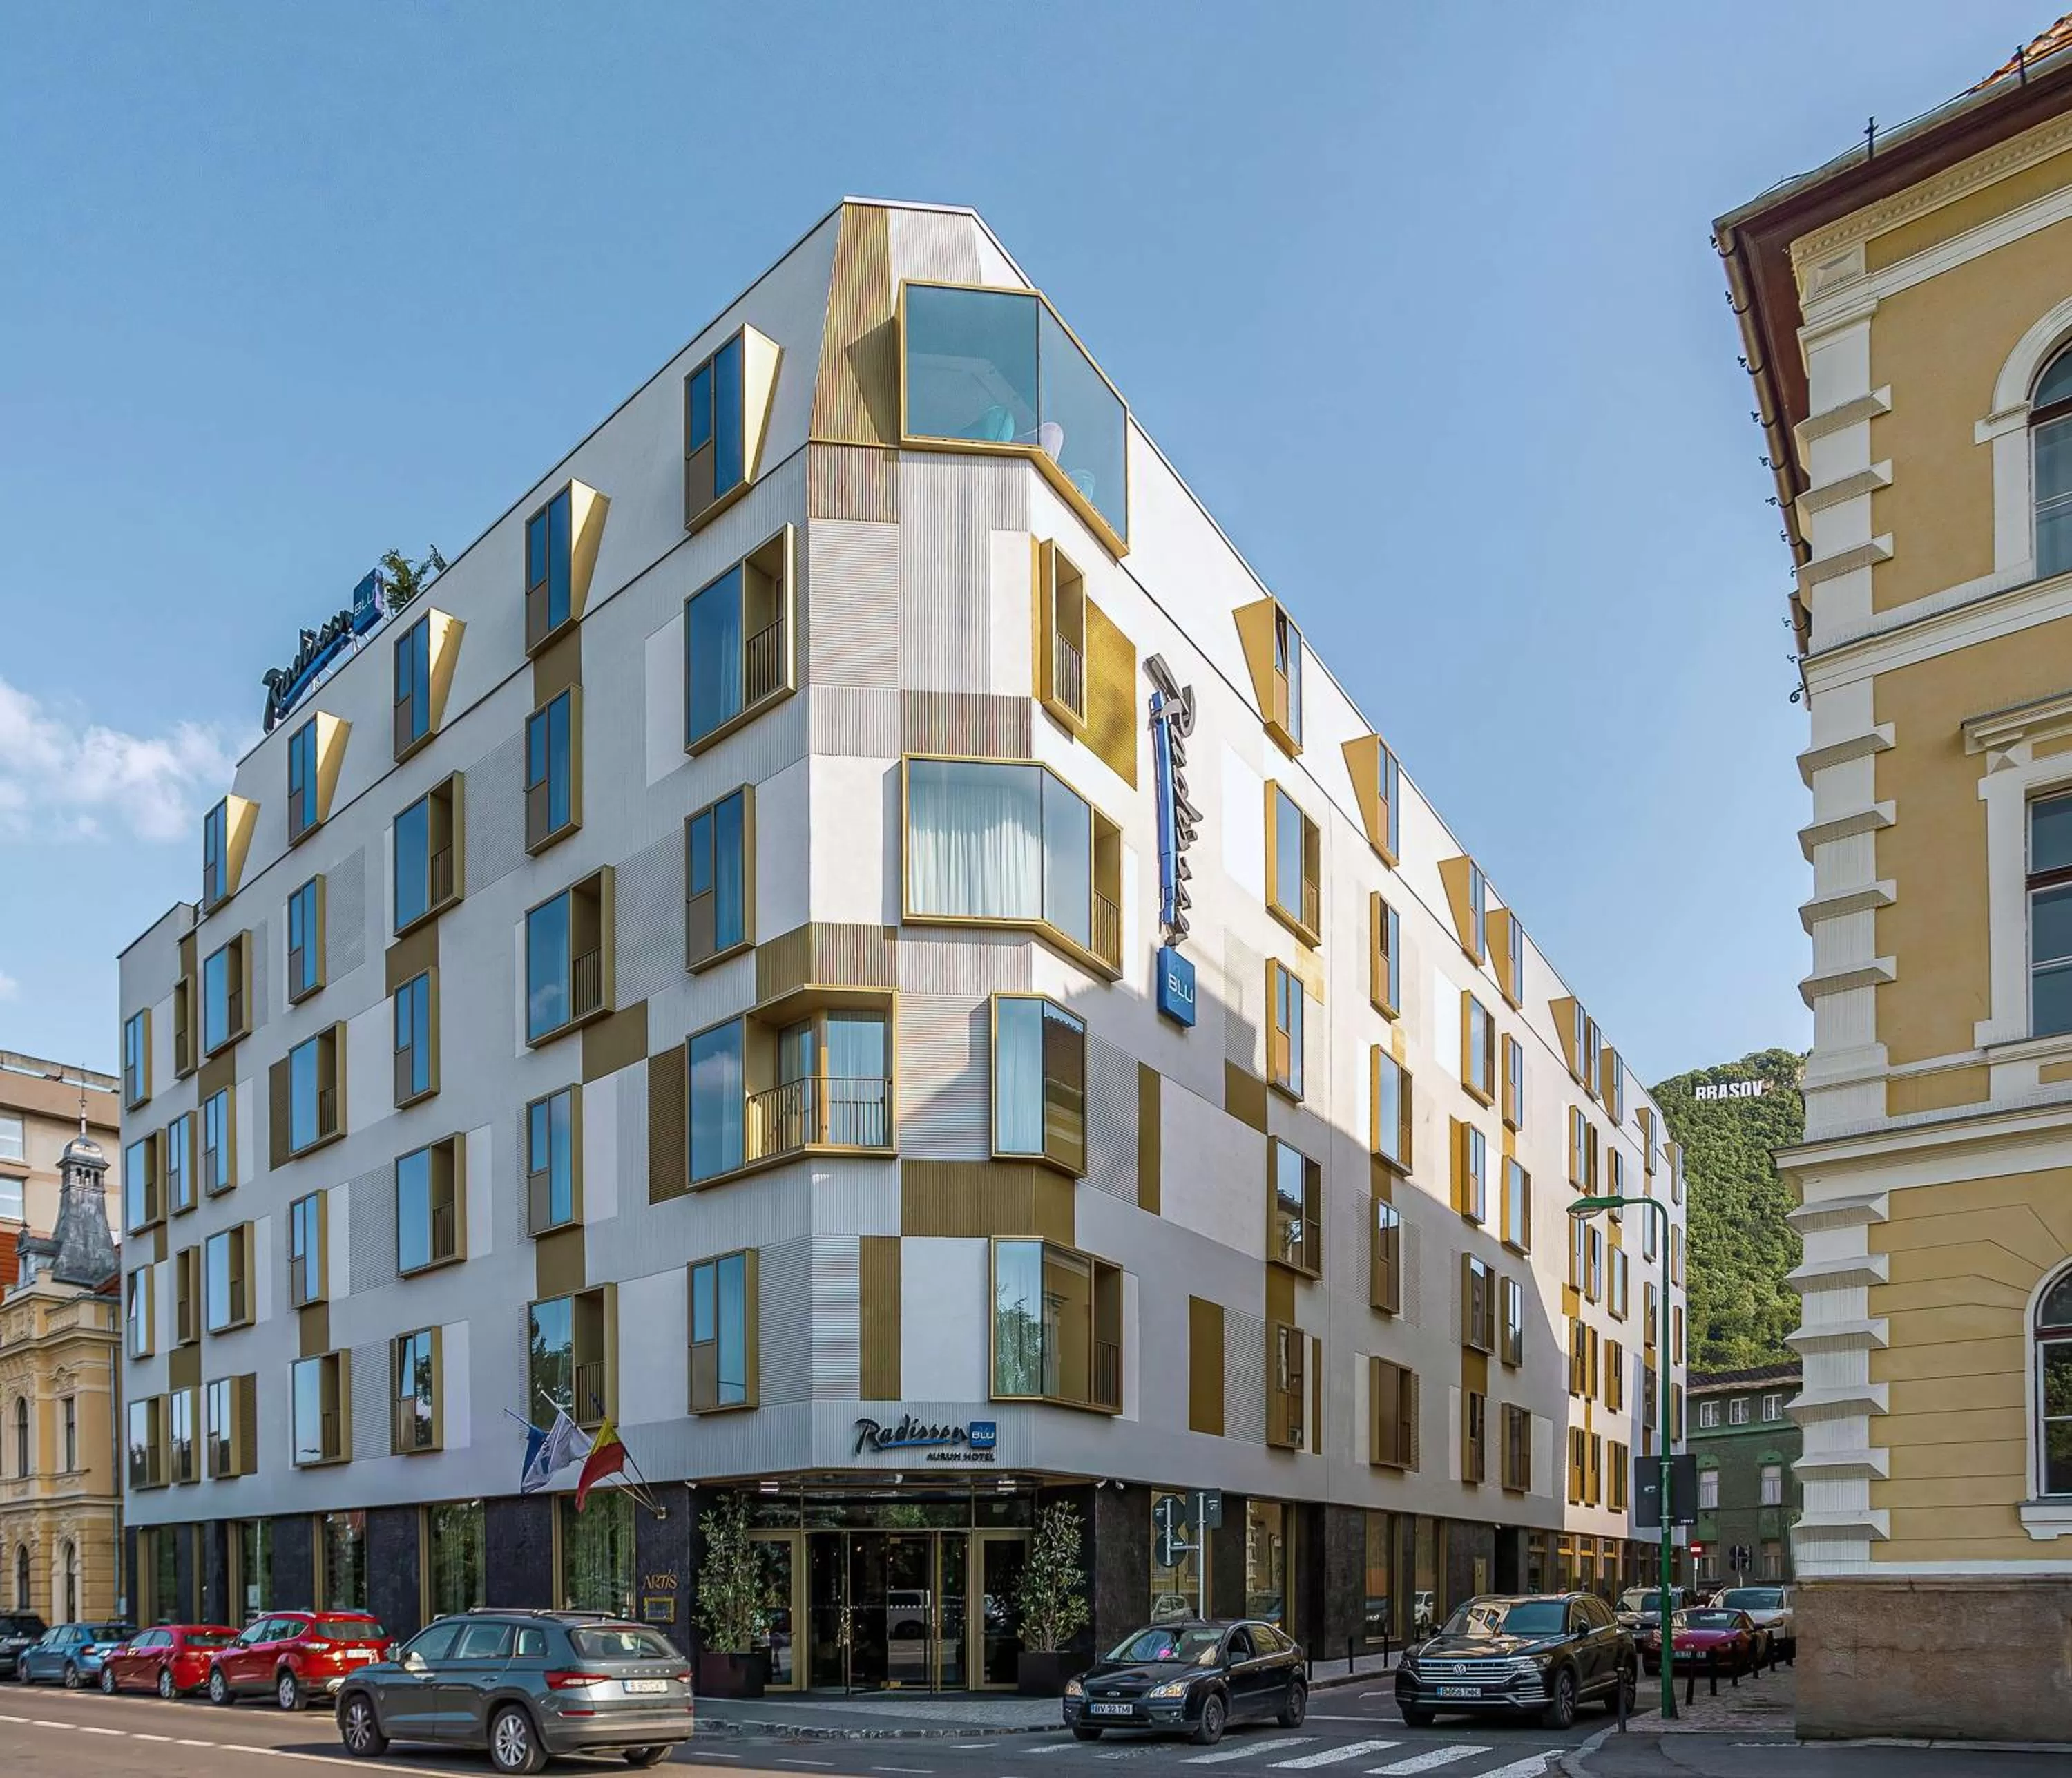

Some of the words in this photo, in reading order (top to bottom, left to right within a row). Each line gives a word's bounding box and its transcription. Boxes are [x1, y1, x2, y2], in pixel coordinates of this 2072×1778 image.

[1167, 971, 1195, 1005] BLU
[854, 1414, 968, 1457] Radisson
[972, 1431, 995, 1439] BLU
[963, 1452, 995, 1462] HOTEL
